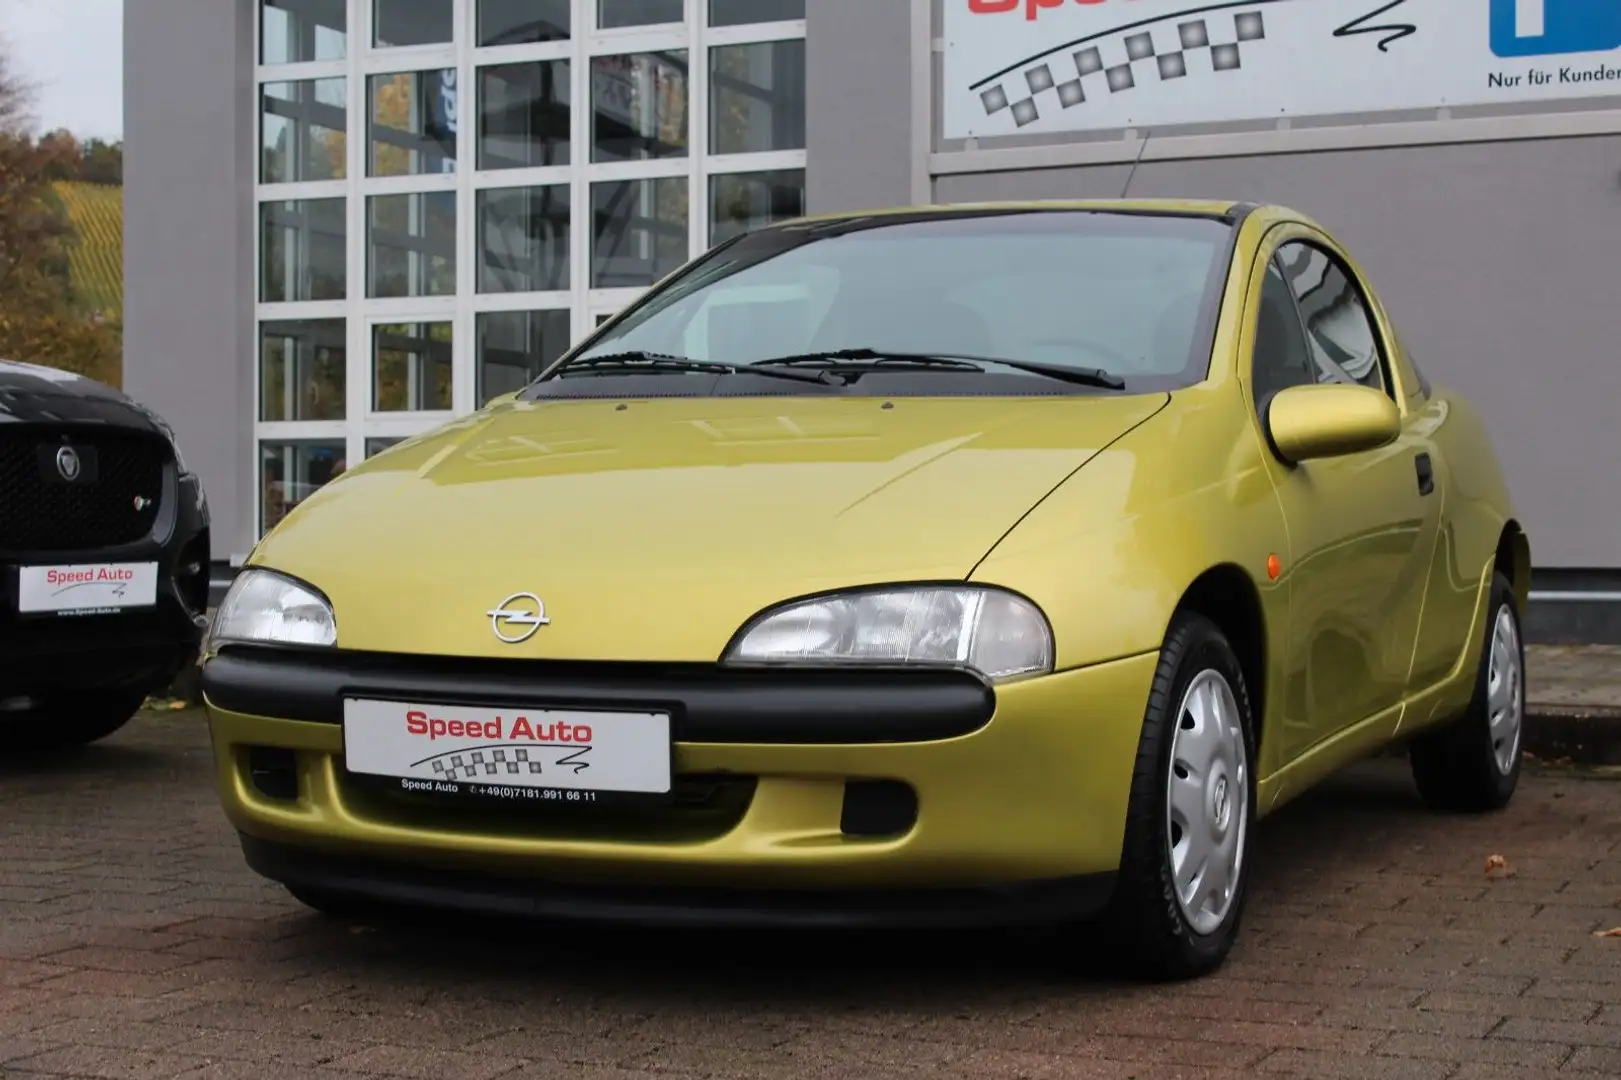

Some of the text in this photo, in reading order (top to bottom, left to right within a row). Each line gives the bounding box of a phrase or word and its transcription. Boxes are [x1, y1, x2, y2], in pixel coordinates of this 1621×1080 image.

[1488, 72, 1522, 88] Nur
[1528, 69, 1552, 85] für
[47, 567, 133, 586] Speed Auto
[406, 711, 593, 743] Speed Auto
[401, 779, 432, 791] Speed
[435, 783, 459, 793] Auto
[584, 792, 596, 802] 11
